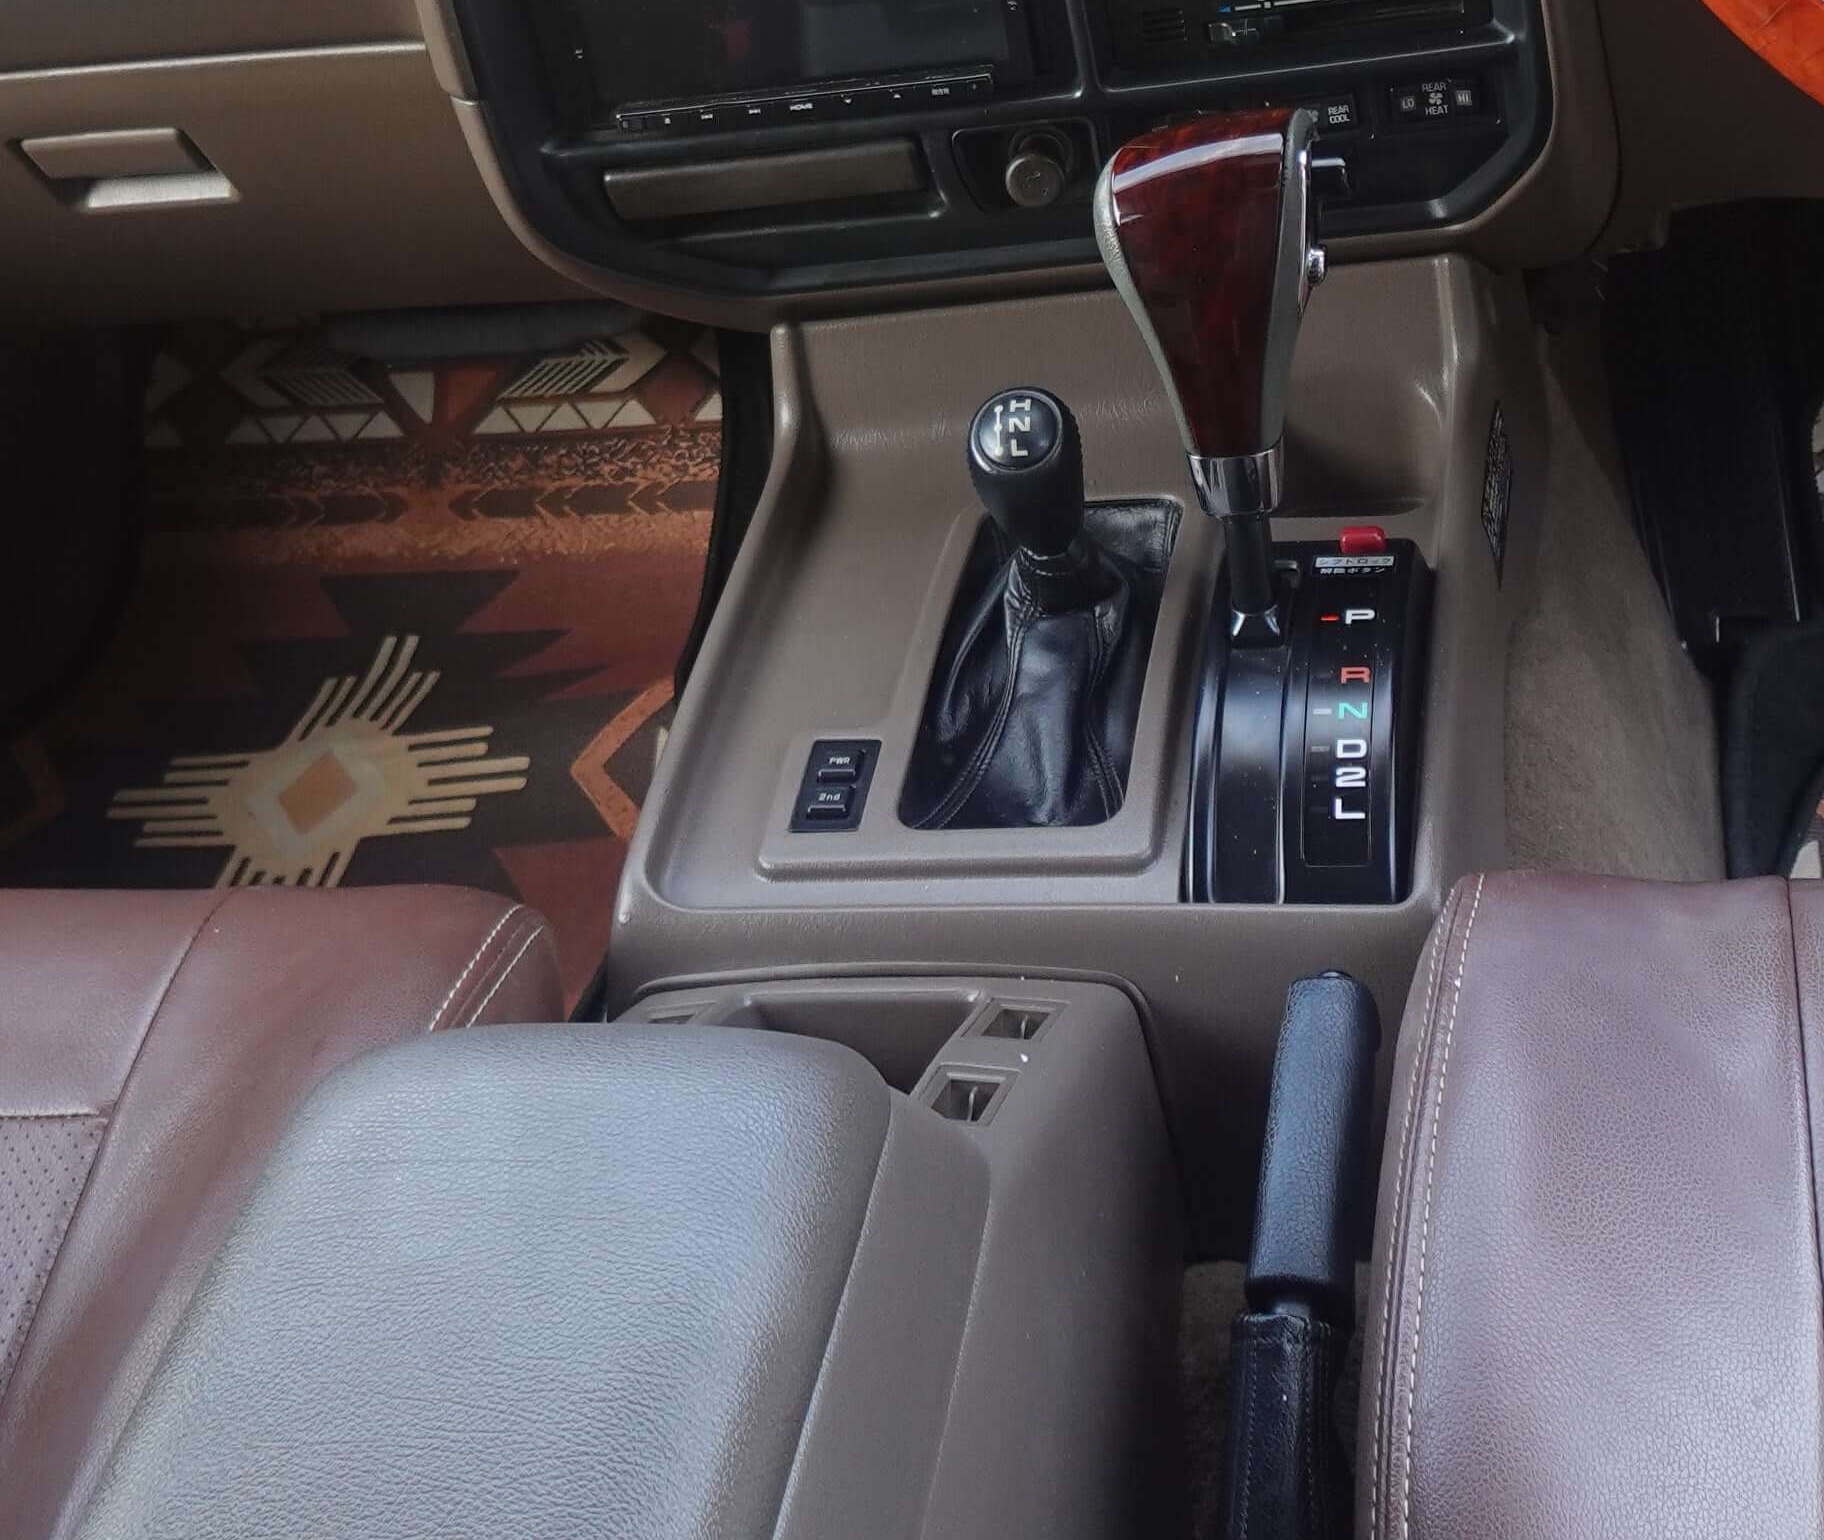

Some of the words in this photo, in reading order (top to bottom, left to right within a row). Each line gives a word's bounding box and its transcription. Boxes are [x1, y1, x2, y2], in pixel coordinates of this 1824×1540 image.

[1422, 82, 1448, 93] REAR
[1402, 98, 1415, 109] LO
[1457, 92, 1470, 105] HI
[1327, 105, 1349, 116] REAR
[1425, 105, 1449, 116] HEAT
[1329, 113, 1351, 125] COOL
[1010, 398, 1032, 413] H
[1008, 417, 1031, 433] N
[1010, 439, 1029, 457] L
[1344, 609, 1376, 625] P
[1340, 666, 1371, 684] R
[1337, 702, 1368, 719] N
[1336, 739, 1367, 758] D
[1335, 766, 1367, 788] 2
[1333, 797, 1366, 820] L
